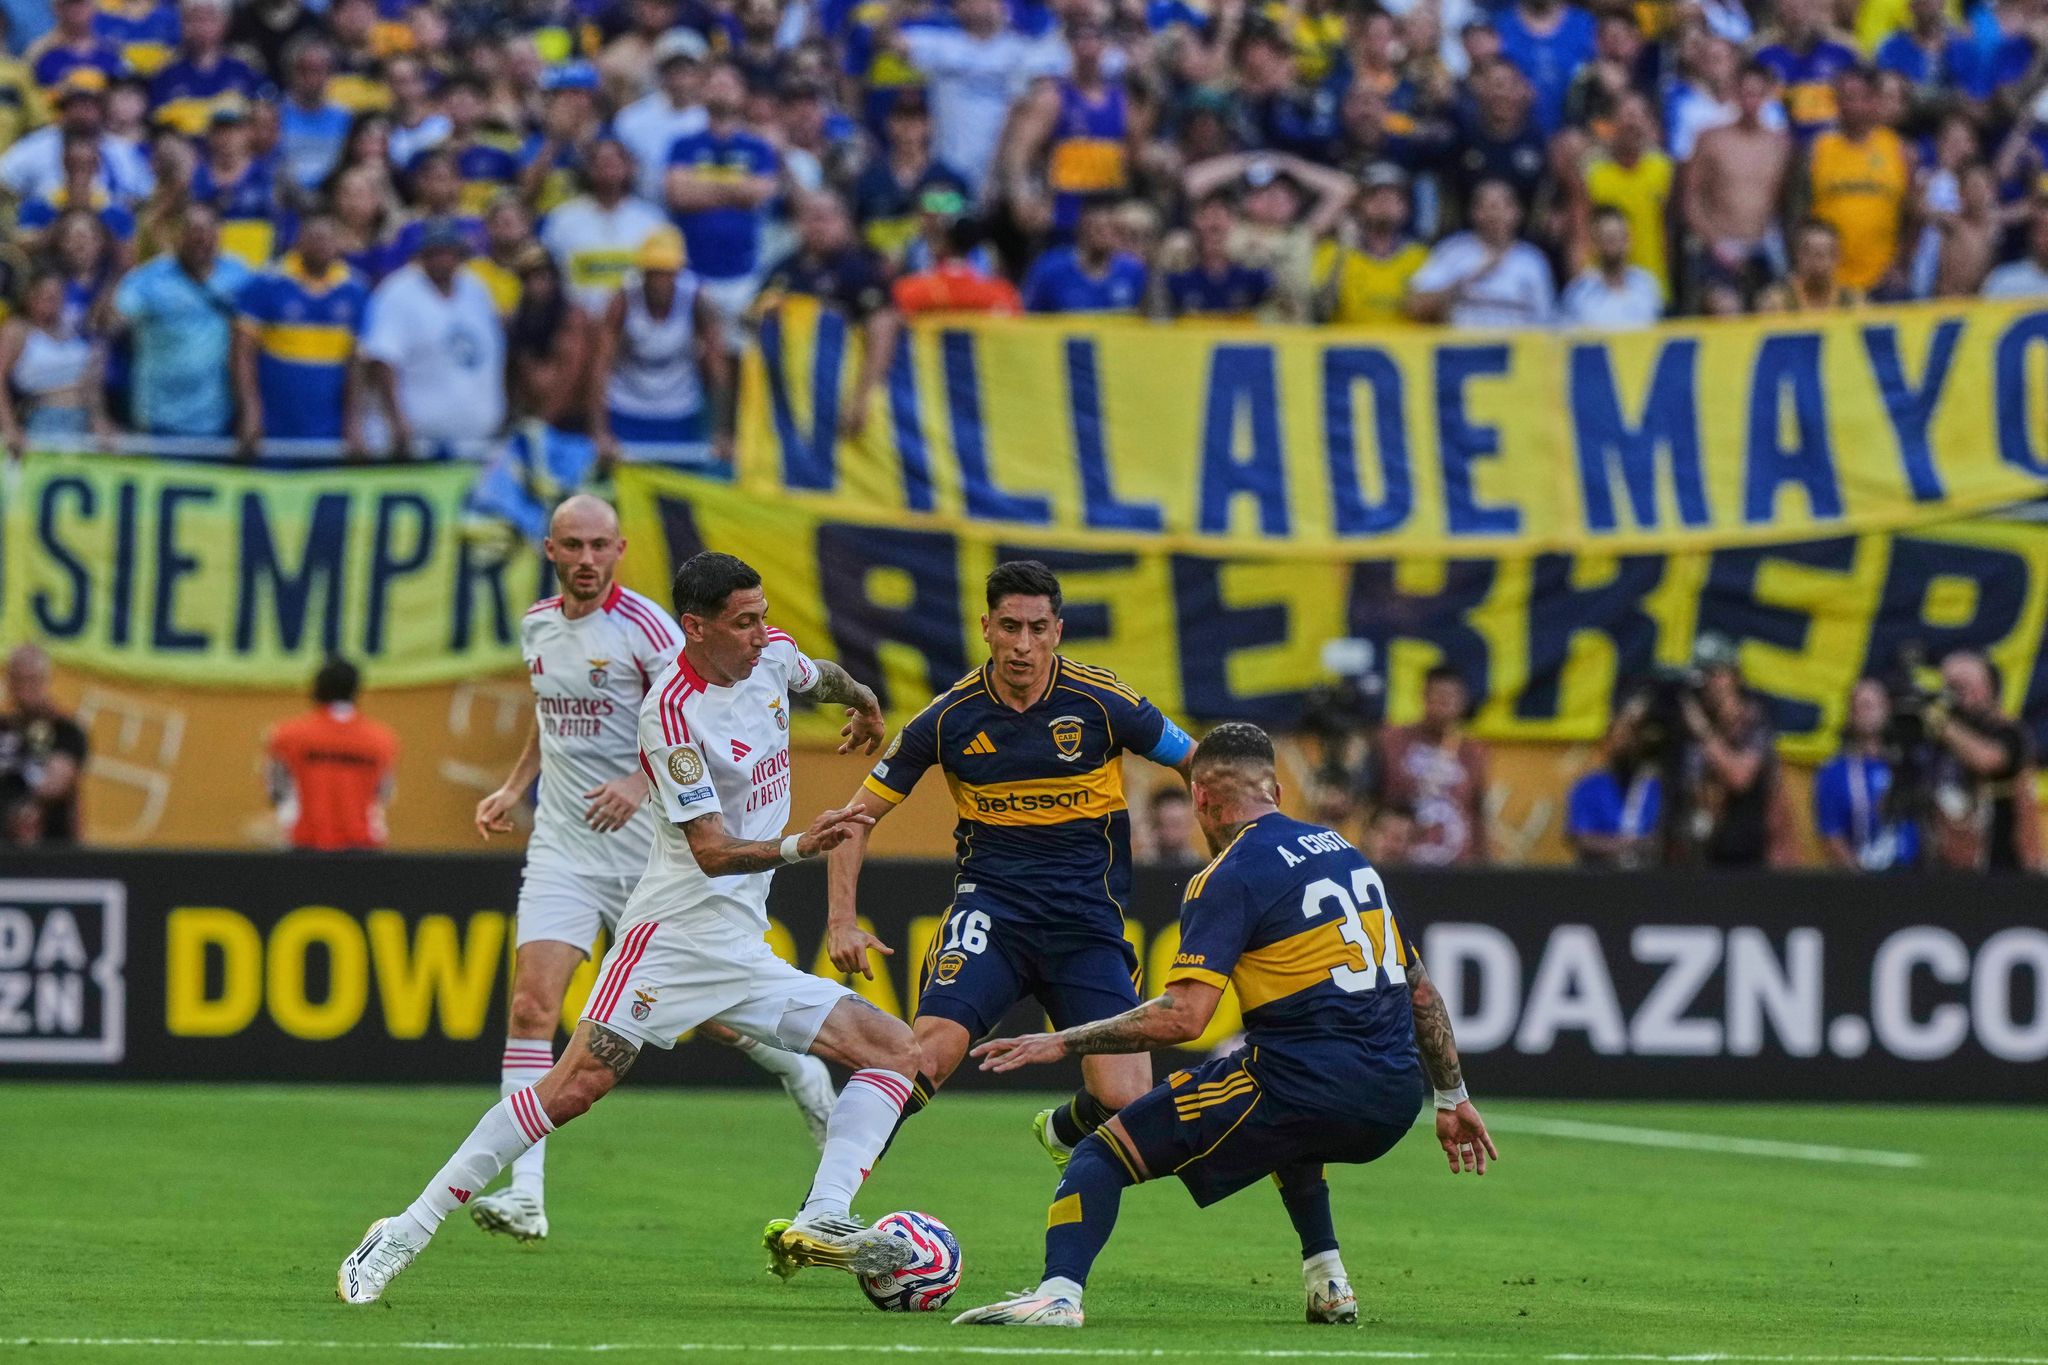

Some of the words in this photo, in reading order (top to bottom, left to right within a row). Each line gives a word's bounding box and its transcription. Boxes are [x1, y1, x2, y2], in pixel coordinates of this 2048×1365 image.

[759, 309, 1290, 536] VILLA
[33, 475, 554, 654] SIEMPR
[540, 692, 614, 717] mirates
[760, 773, 789, 807] BETTE
[975, 789, 1090, 813] betsson
[1277, 845, 1306, 868] A.
[943, 909, 992, 955] 16
[1302, 867, 1407, 993] 32
